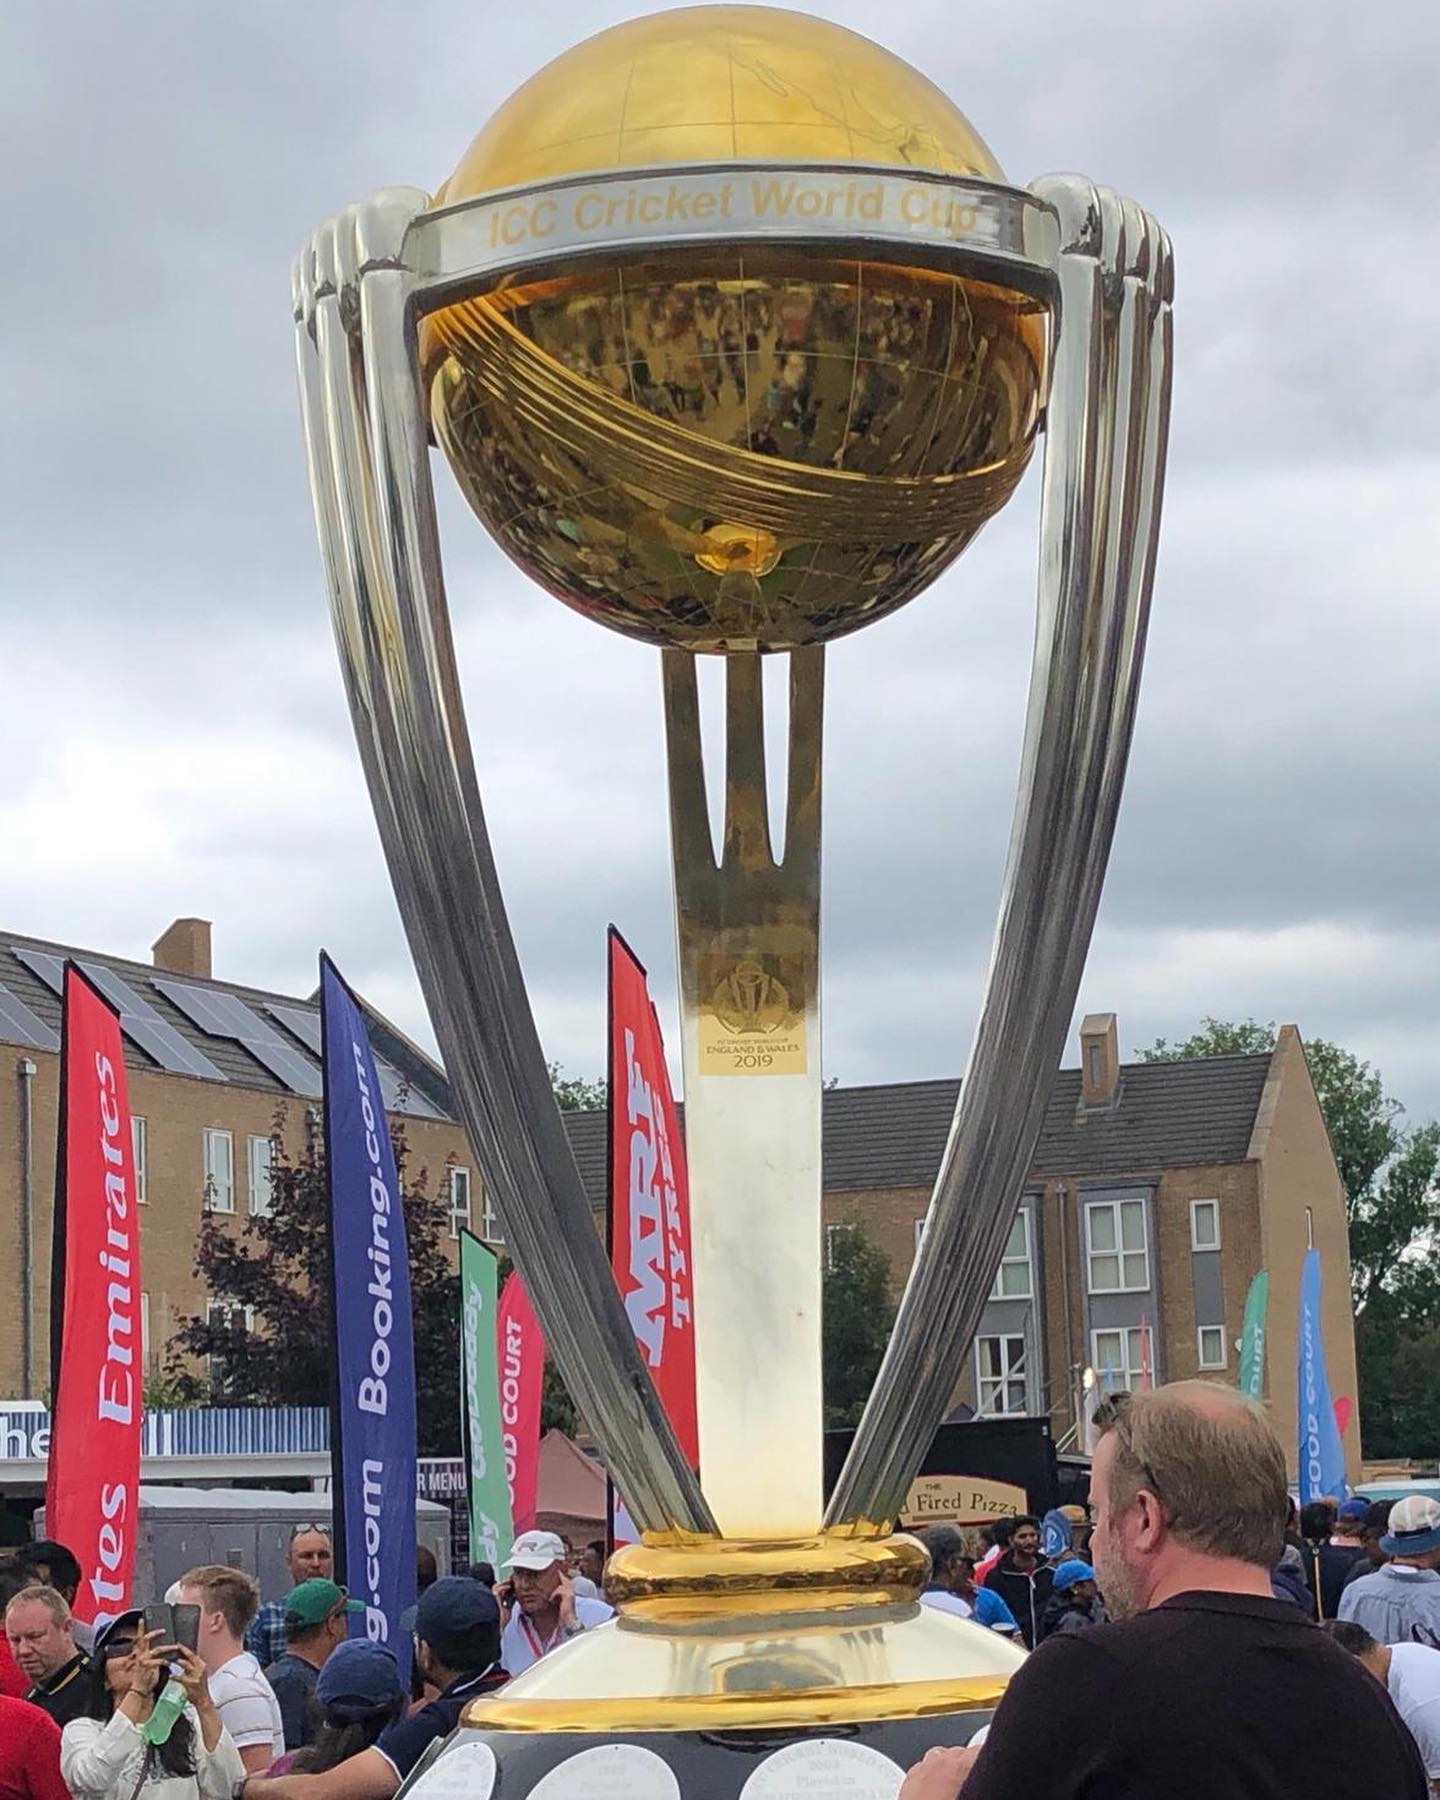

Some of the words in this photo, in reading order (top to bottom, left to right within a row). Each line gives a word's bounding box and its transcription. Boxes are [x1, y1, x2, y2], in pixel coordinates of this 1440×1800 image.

[488, 201, 558, 248] ICC
[573, 183, 732, 231] Cricket
[754, 180, 885, 220] World
[901, 185, 977, 241] Cup
[706, 1045, 755, 1054] ENGLAND
[765, 1043, 800, 1053] WALES
[734, 1054, 773, 1068] 2019
[95, 1050, 133, 1426] Emirates
[352, 1041, 393, 1416] Booking.com
[623, 1027, 667, 1367] MRF
[651, 1089, 691, 1330] TYRES
[502, 1315, 522, 1425] COURT
[1304, 1303, 1317, 1405] COURT
[428, 1472, 467, 1491] MENU
[503, 1433, 518, 1508] OD
[917, 1491, 961, 1512] Fired
[1308, 1413, 1323, 1501] FOOD
[89, 1483, 127, 1632] tes
